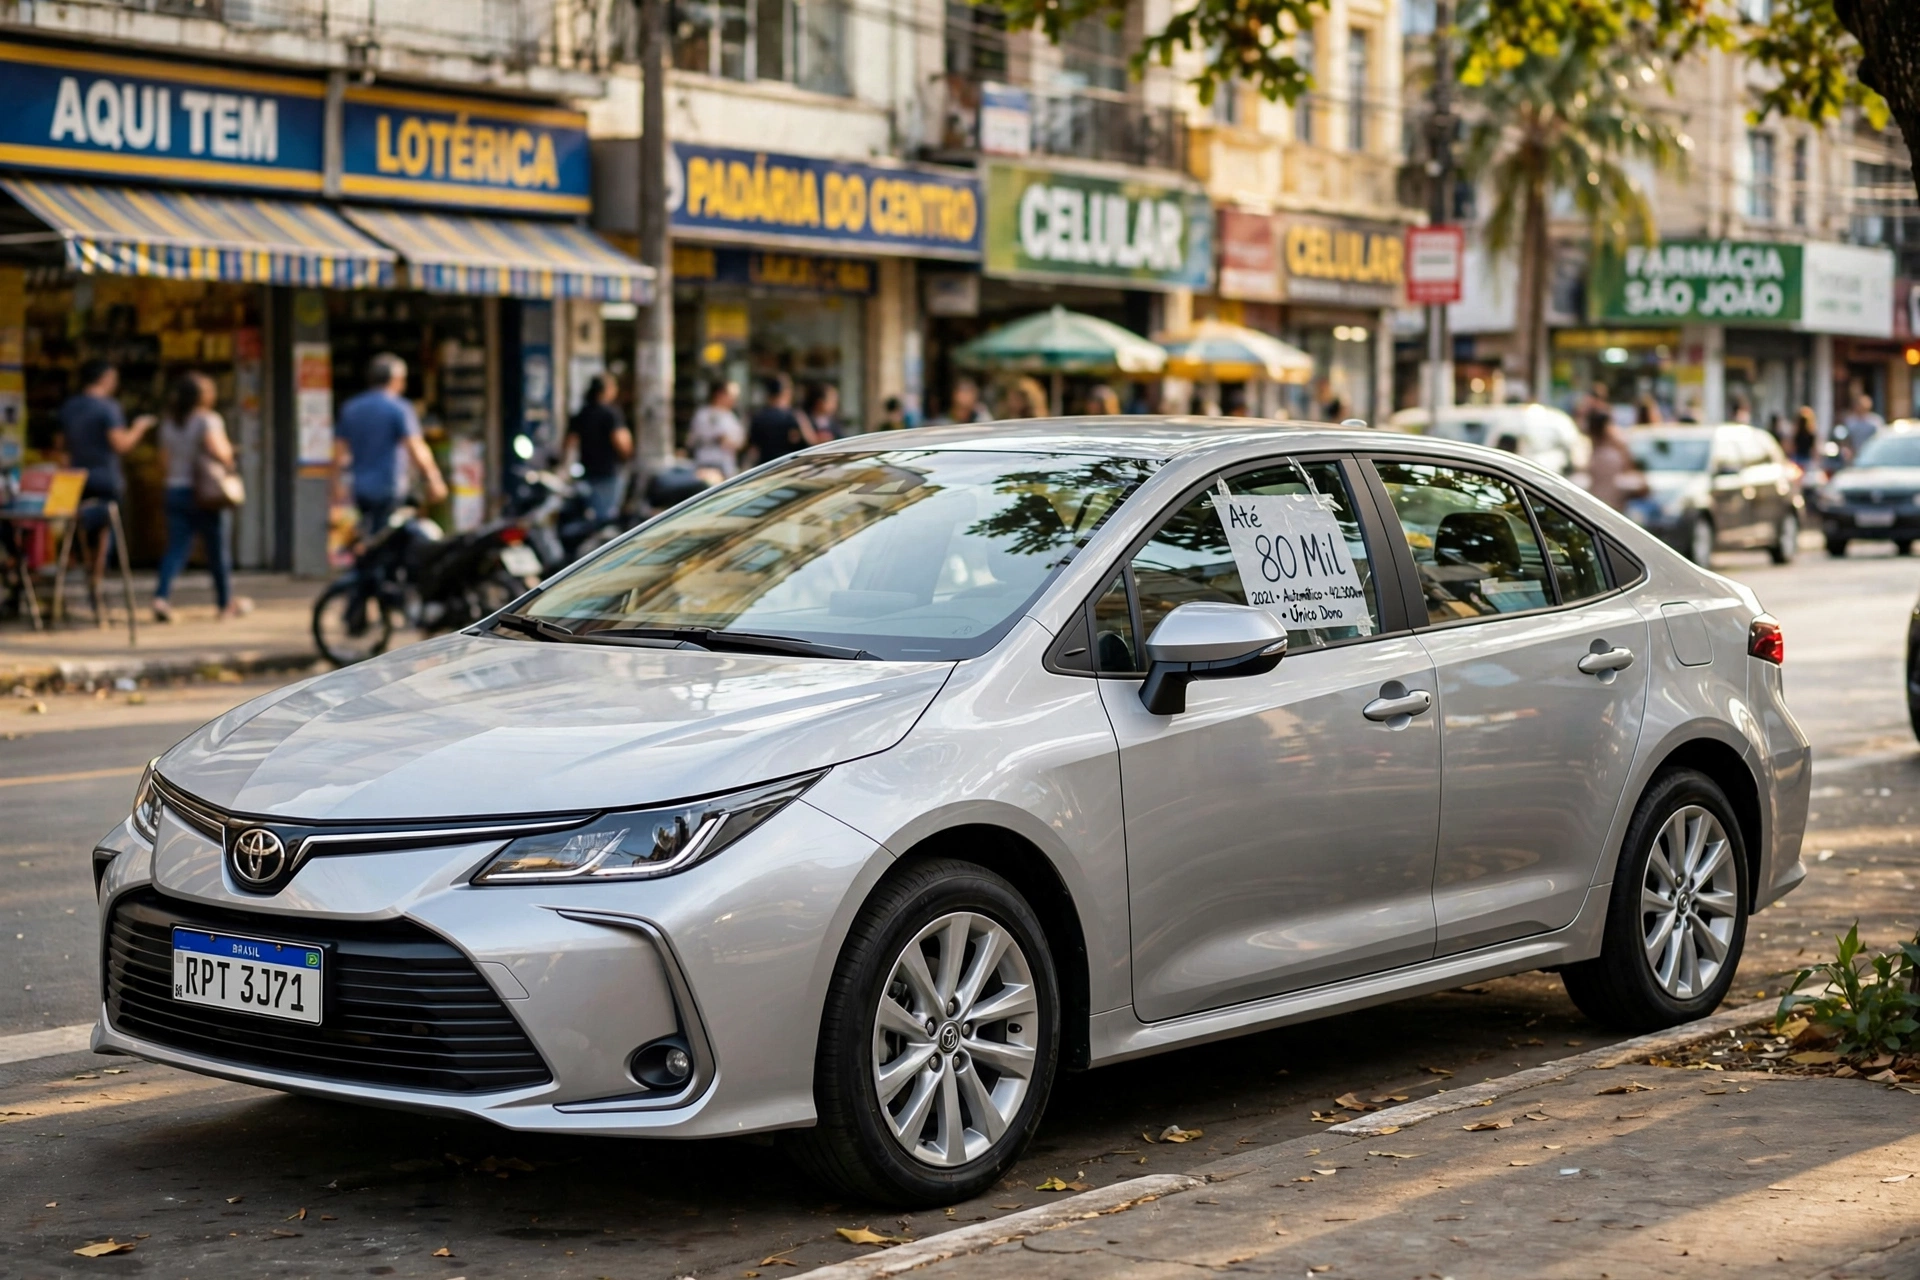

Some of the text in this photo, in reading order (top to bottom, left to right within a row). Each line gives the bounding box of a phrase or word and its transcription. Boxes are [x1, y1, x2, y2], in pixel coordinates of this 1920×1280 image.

[50, 76, 278, 162] AQUI TEM
[375, 111, 560, 189] LOTÉRICA
[823, 171, 867, 232] DO
[869, 177, 978, 242] CENTRO
[1020, 183, 1184, 271] CELULAR
[1285, 224, 1404, 284] CELULAR
[1624, 240, 1785, 282] FARMÁCIA
[1623, 278, 1695, 317] SÃO
[1697, 278, 1785, 317] JOÃO
[1229, 504, 1263, 529] Até
[1255, 532, 1346, 583] 80 Mil
[1251, 591, 1275, 605] 2021
[1290, 604, 1343, 623] Único Dono
[232, 943, 261, 958] BRASIL
[185, 956, 305, 1013] RPT 3J71
